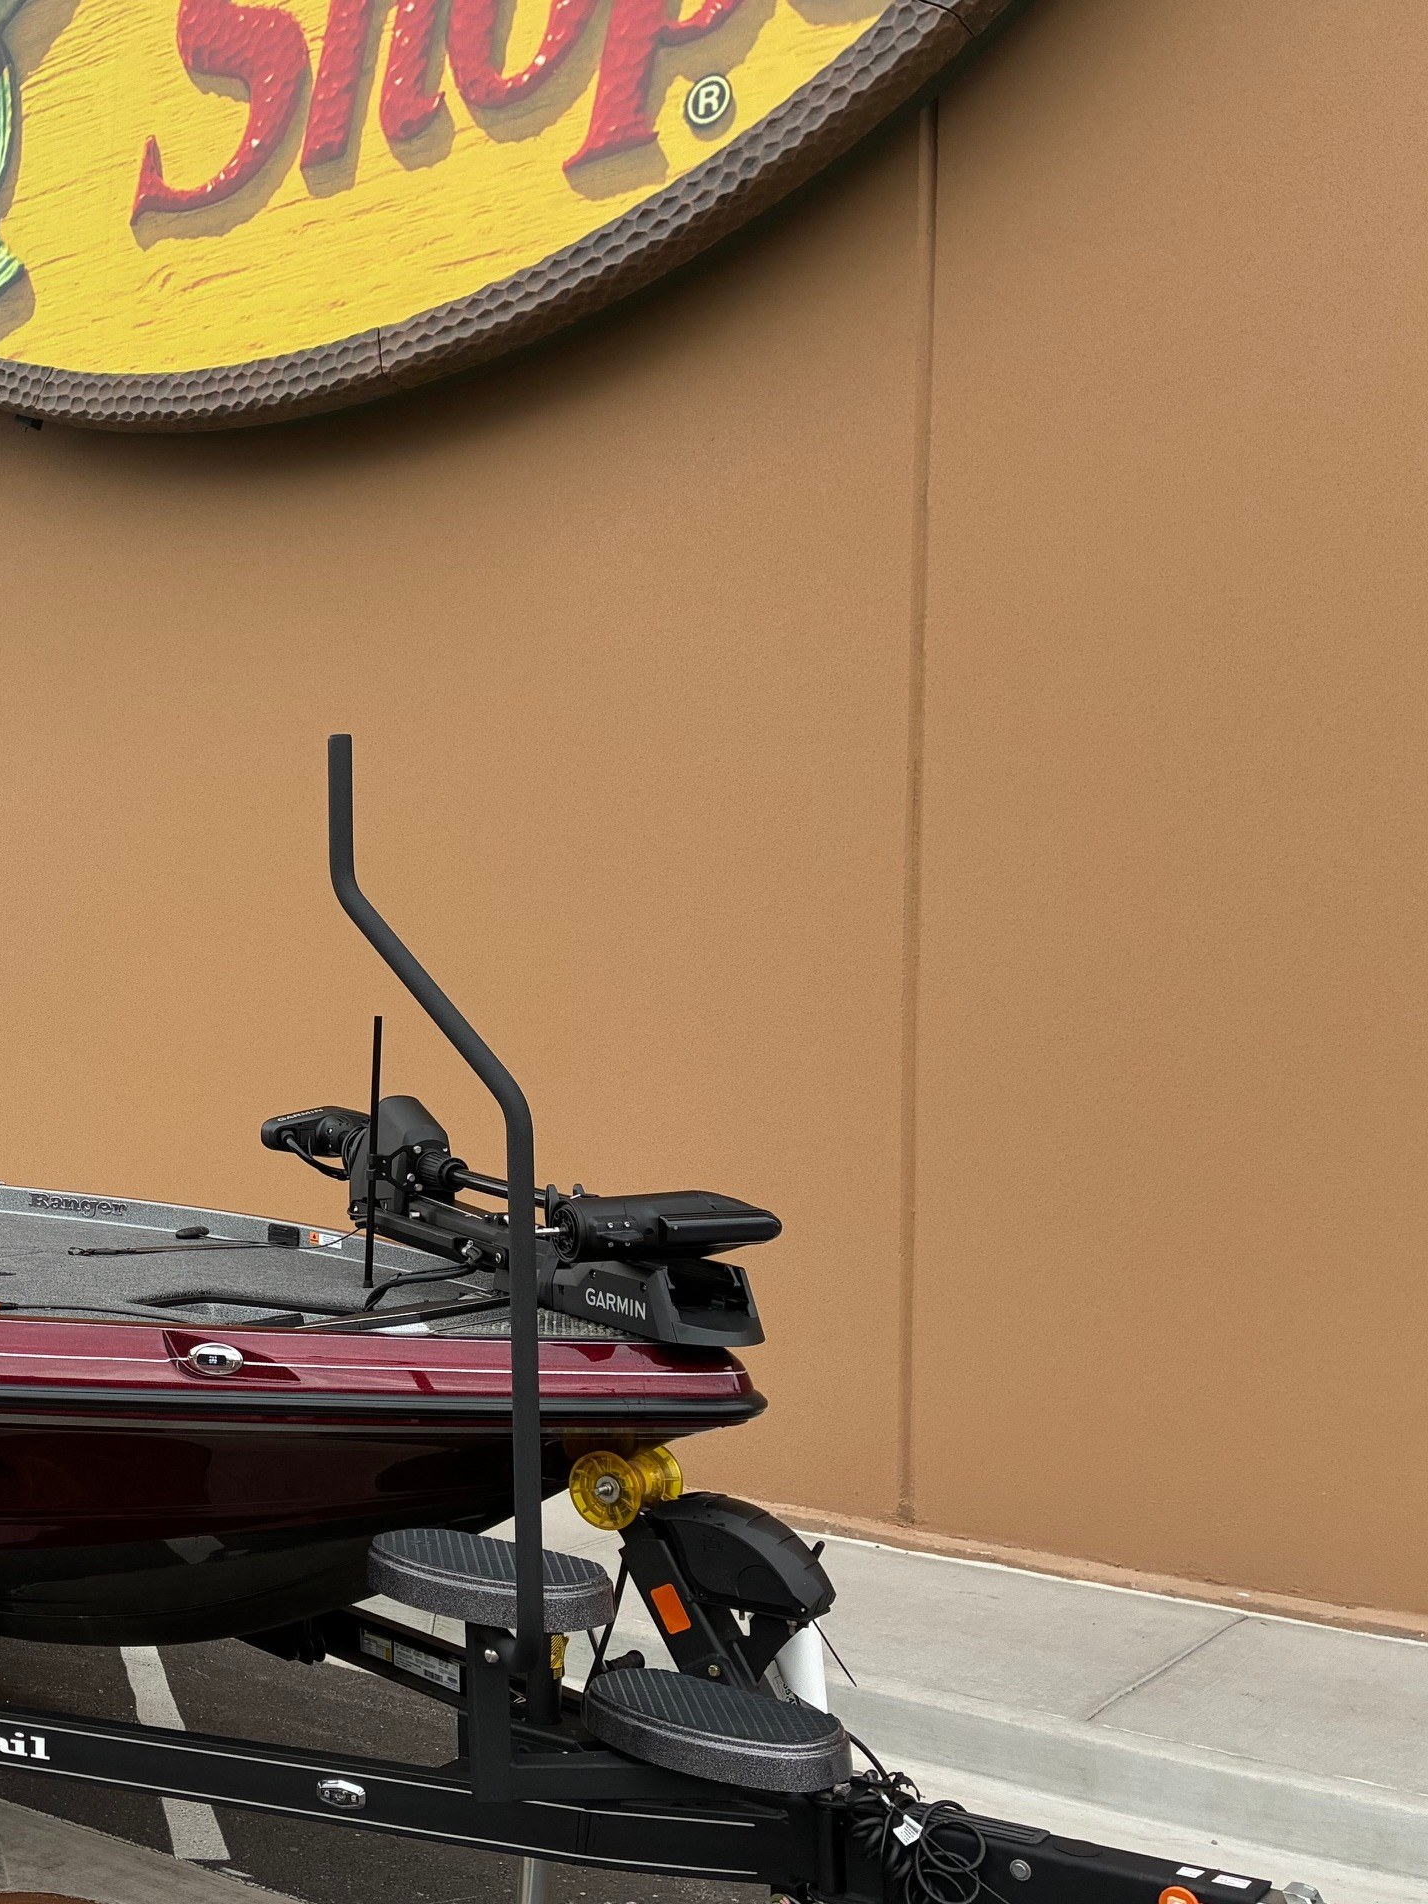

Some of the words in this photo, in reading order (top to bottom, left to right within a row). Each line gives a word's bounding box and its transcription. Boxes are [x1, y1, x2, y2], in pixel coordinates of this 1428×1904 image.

[276, 1108, 324, 1122] GARMIN
[28, 1191, 128, 1218] Ranger
[585, 1287, 646, 1321] GARMIN
